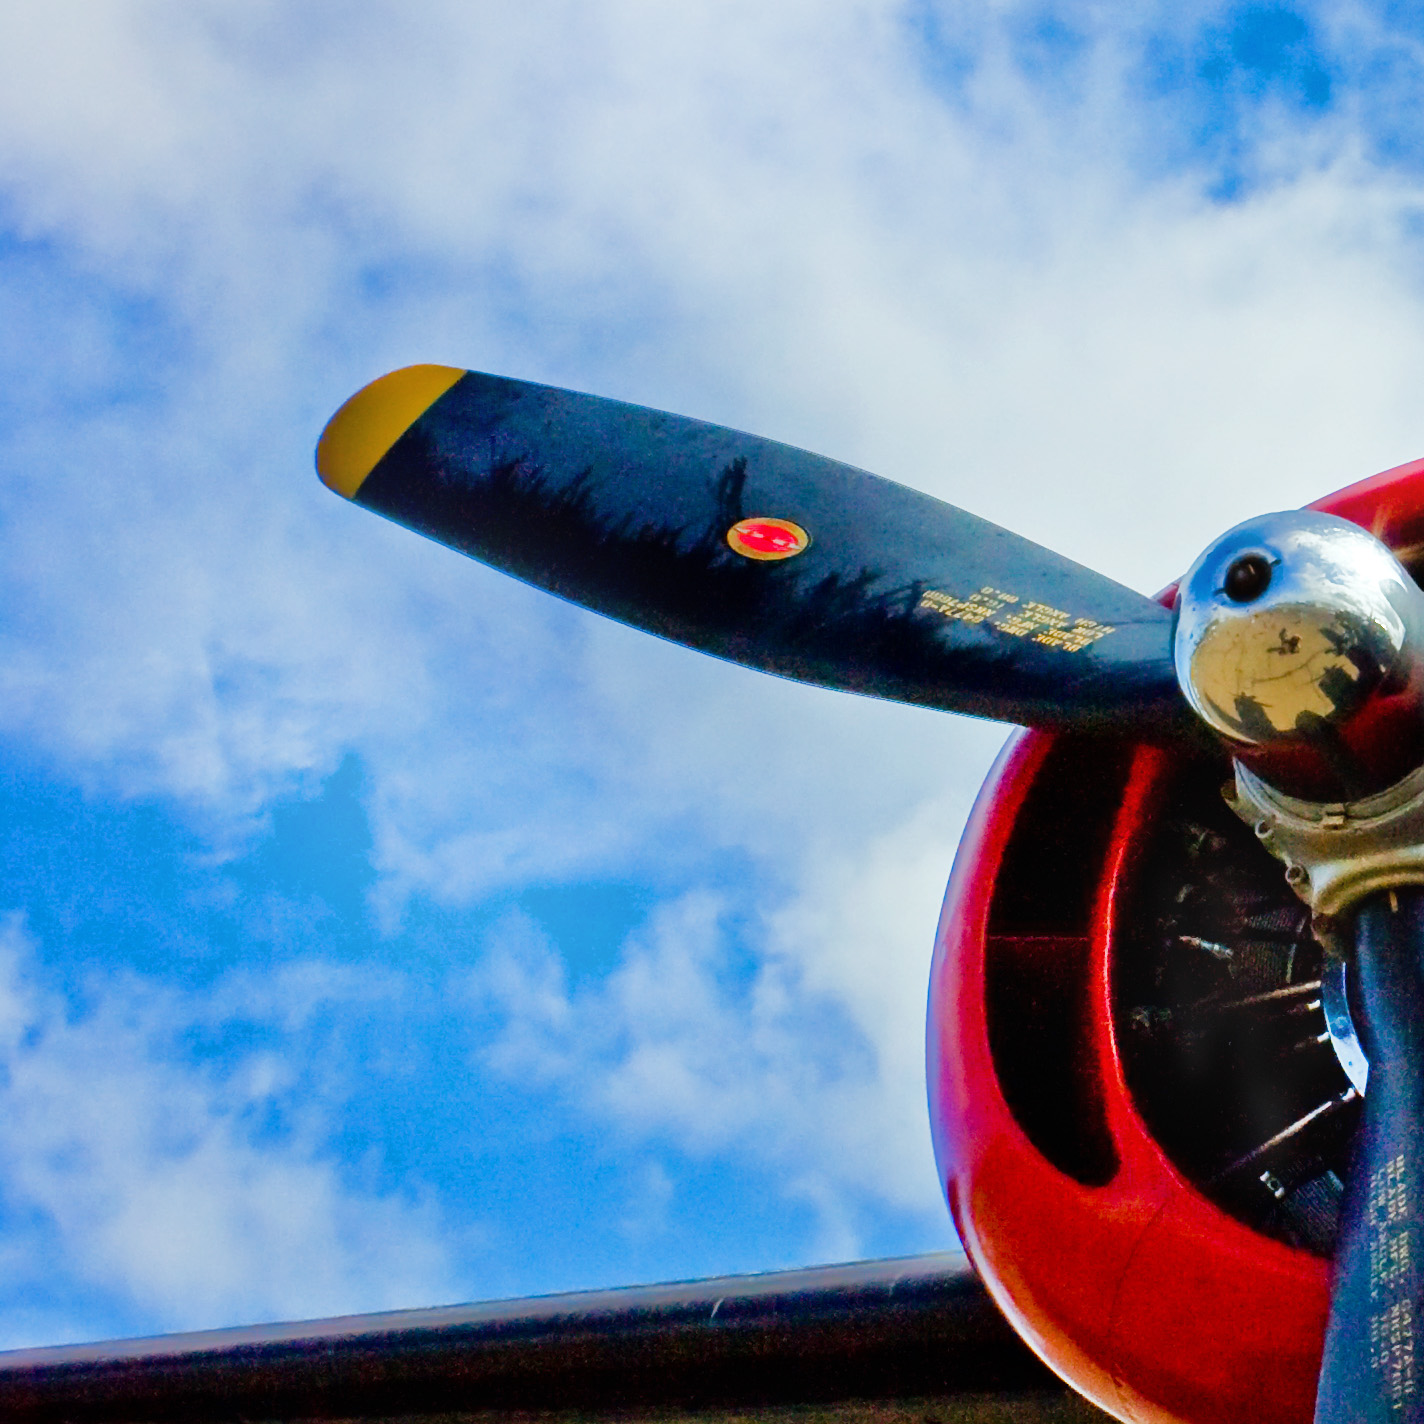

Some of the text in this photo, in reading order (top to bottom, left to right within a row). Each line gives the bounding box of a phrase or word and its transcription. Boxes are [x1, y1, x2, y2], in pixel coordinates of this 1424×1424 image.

[1019, 611, 1068, 627] ANGLE
[1023, 602, 1070, 619] ANGLE
[1032, 634, 1082, 651] BLADE
[1044, 628, 1093, 646] BLADE
[1393, 1155, 1407, 1219] BLADE
